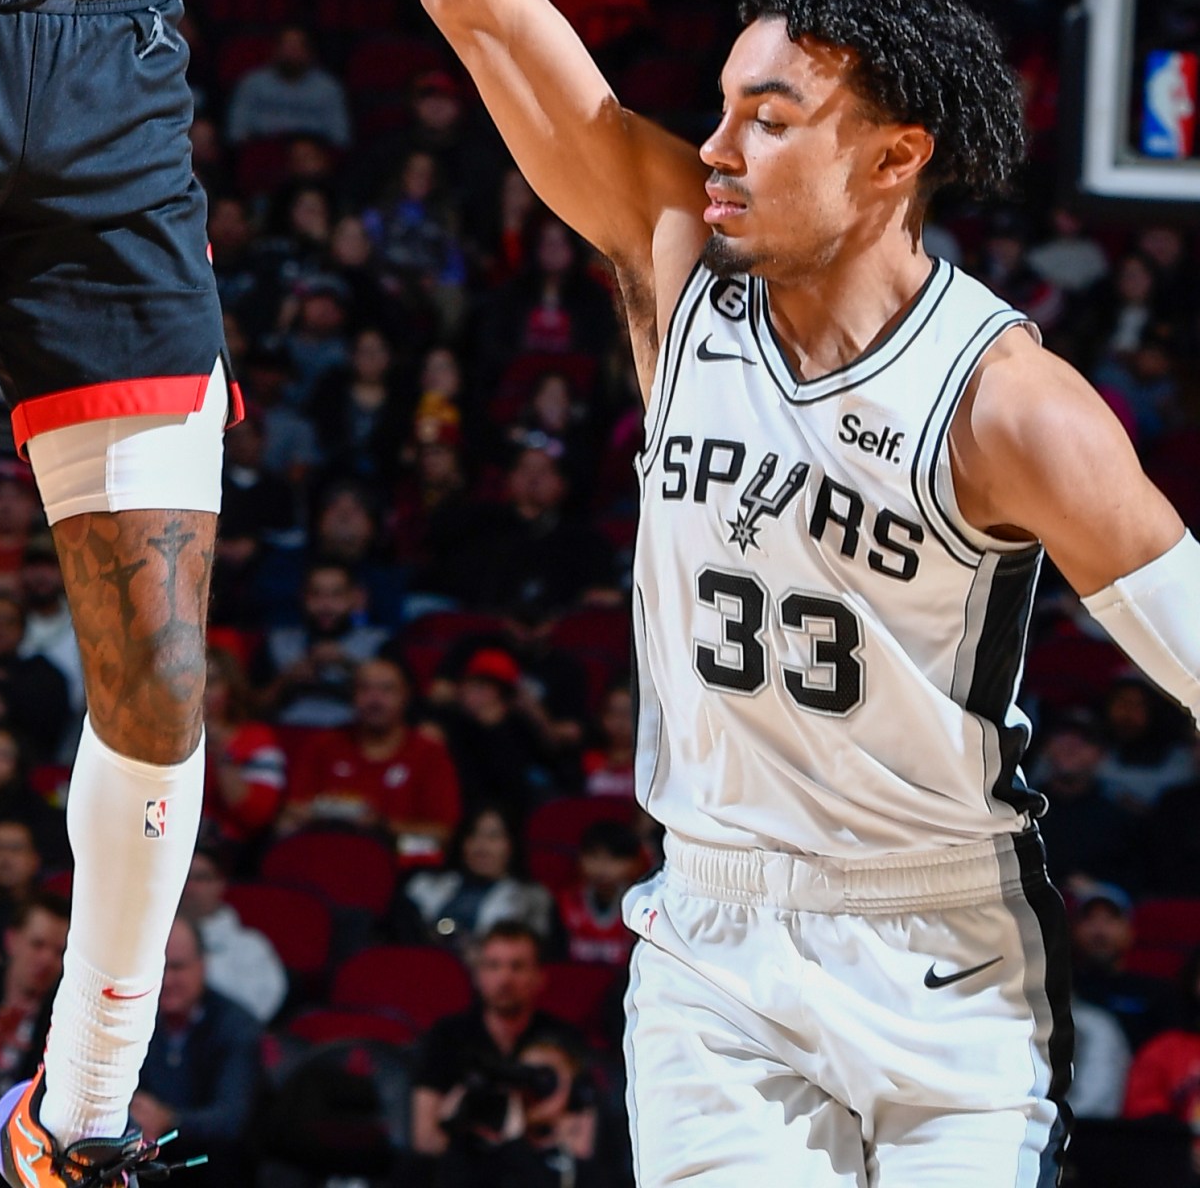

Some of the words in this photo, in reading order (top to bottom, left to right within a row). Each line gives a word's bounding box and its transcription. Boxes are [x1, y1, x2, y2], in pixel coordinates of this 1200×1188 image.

[662, 435, 925, 583] SPURS
[838, 414, 905, 465] Self.
[692, 562, 868, 718] 33
